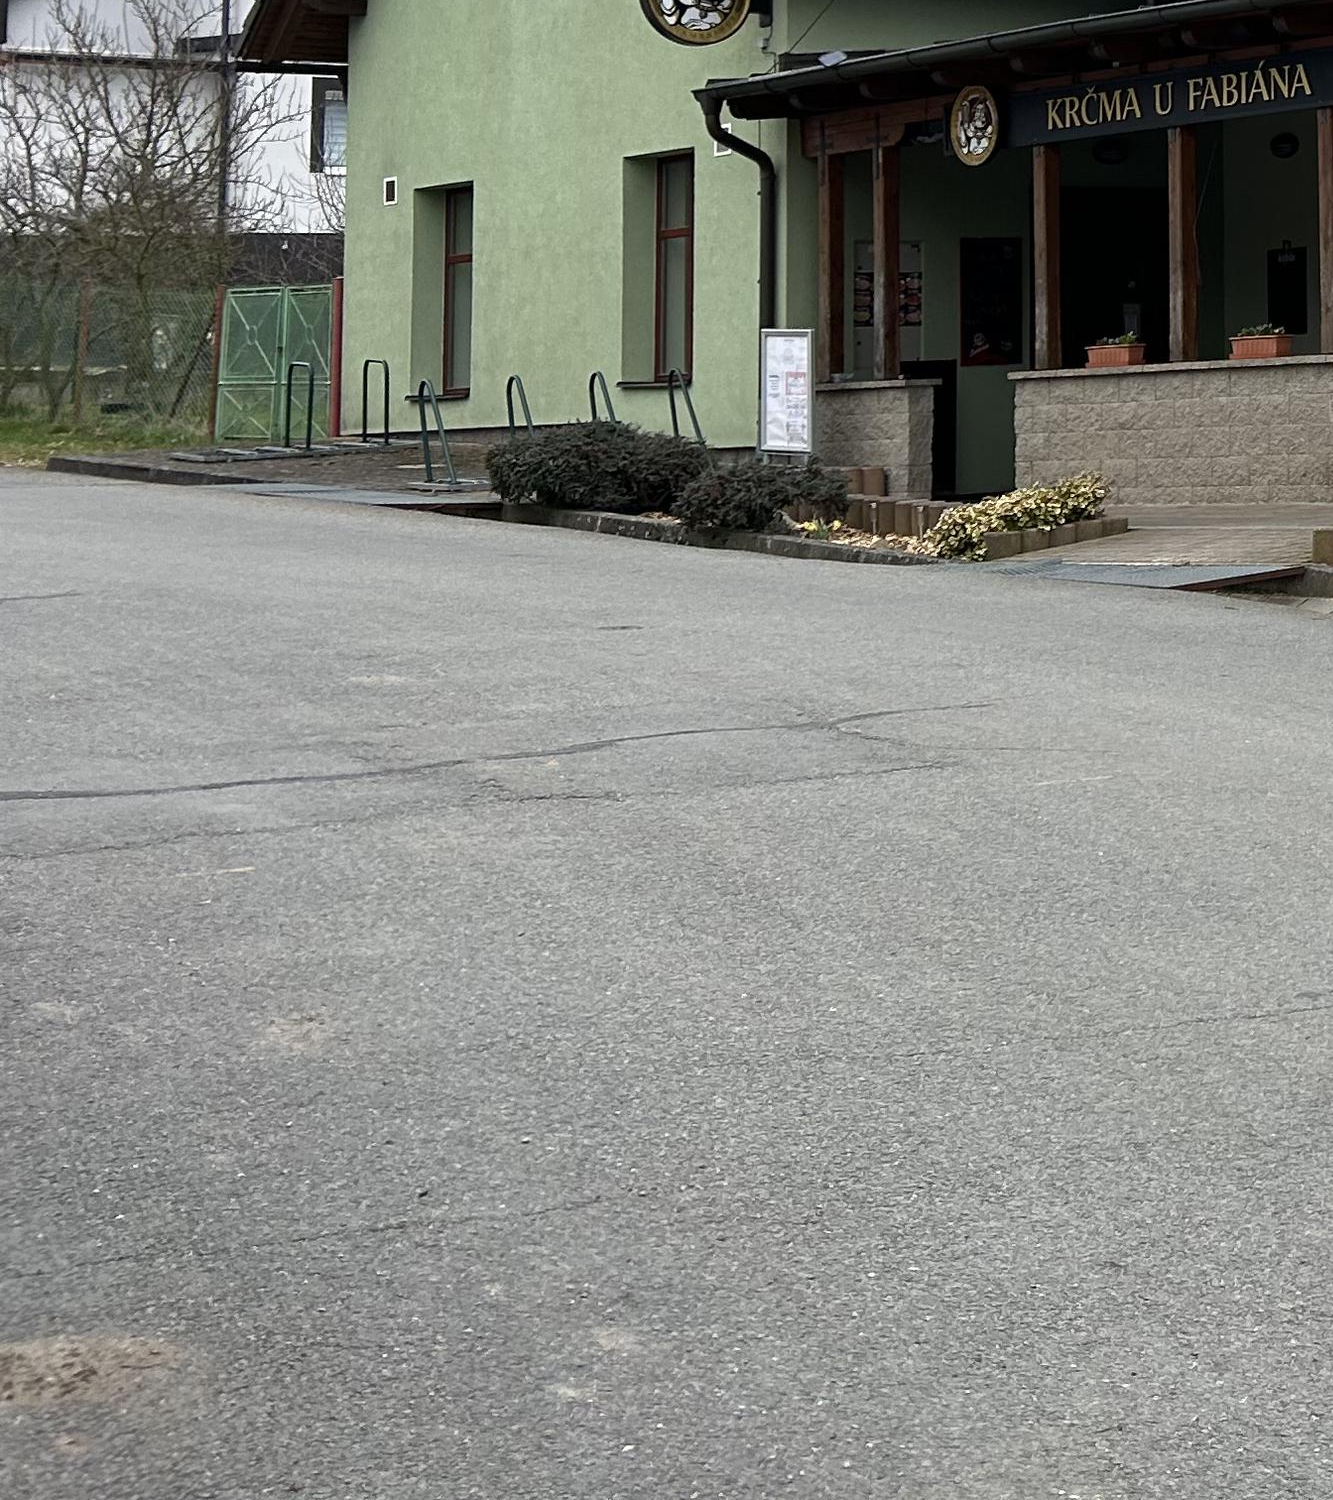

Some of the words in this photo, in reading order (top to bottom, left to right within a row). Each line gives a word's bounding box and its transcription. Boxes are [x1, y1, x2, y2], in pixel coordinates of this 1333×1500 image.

[1045, 86, 1142, 131] KRČMA
[1153, 80, 1173, 116] U
[1186, 59, 1313, 111] FABIÁNA
